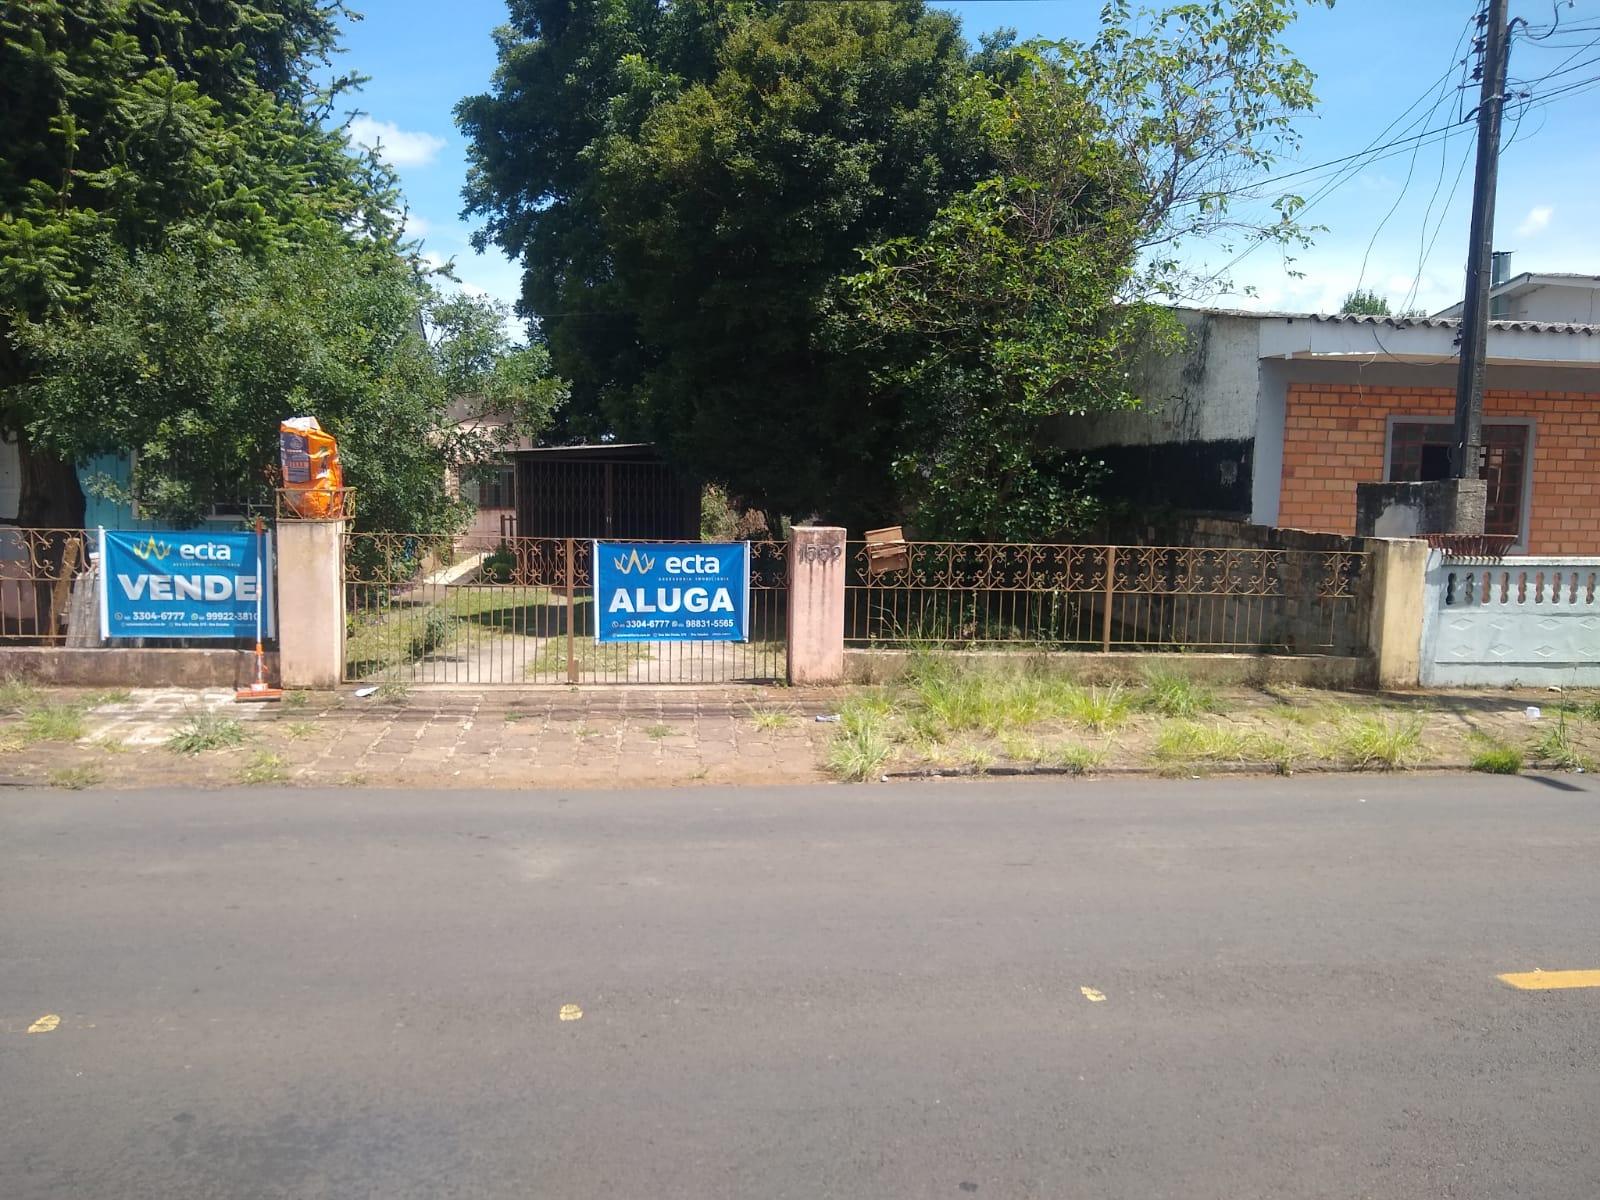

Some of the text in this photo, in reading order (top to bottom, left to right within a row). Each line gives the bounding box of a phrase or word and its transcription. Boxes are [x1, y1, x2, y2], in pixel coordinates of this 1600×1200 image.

[179, 541, 231, 561] ecta
[665, 554, 720, 574] ecta
[117, 574, 257, 601] VENDE
[608, 587, 735, 613] ALUGA
[132, 611, 185, 621] 3304-6777
[626, 619, 670, 629] 3304-6777
